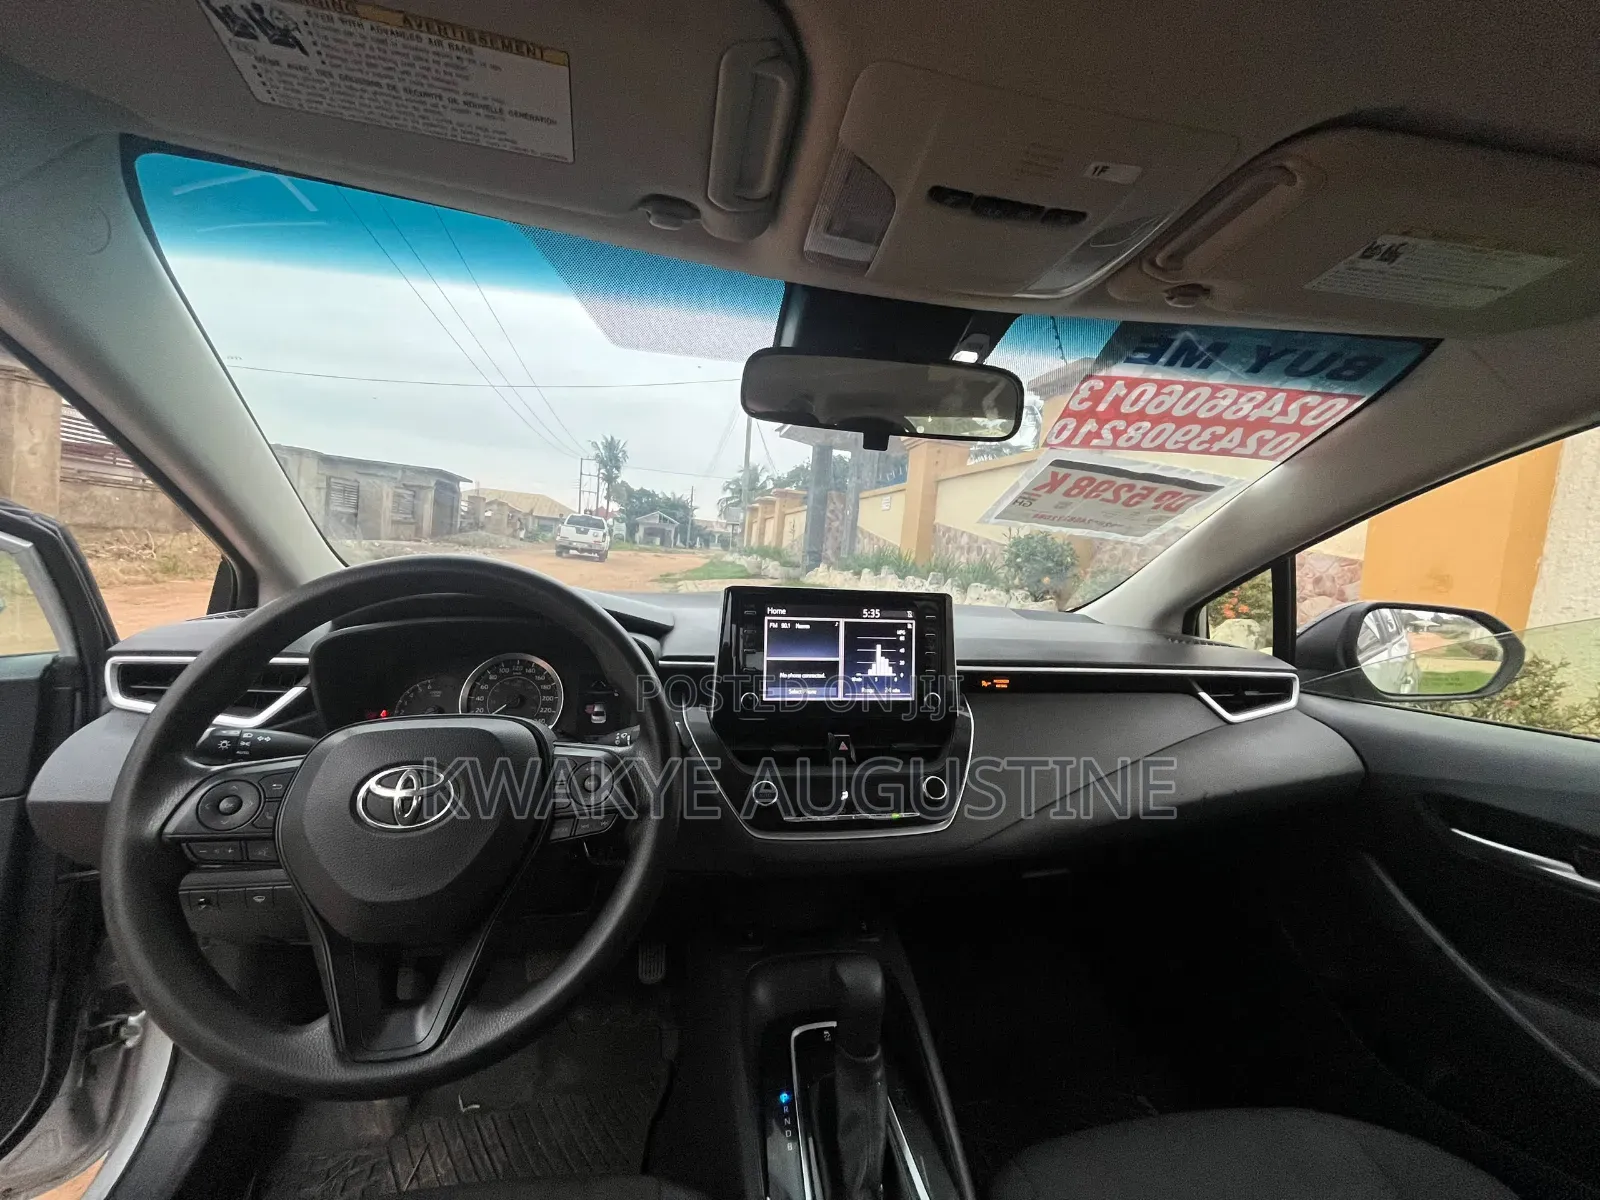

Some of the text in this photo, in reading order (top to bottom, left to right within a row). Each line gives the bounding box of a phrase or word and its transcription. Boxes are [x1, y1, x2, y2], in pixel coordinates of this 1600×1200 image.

[767, 606, 786, 615] Home
[862, 608, 881, 618] 5:35
[783, 1105, 789, 1113] R
[784, 1117, 791, 1125] N
[785, 1129, 792, 1138] D
